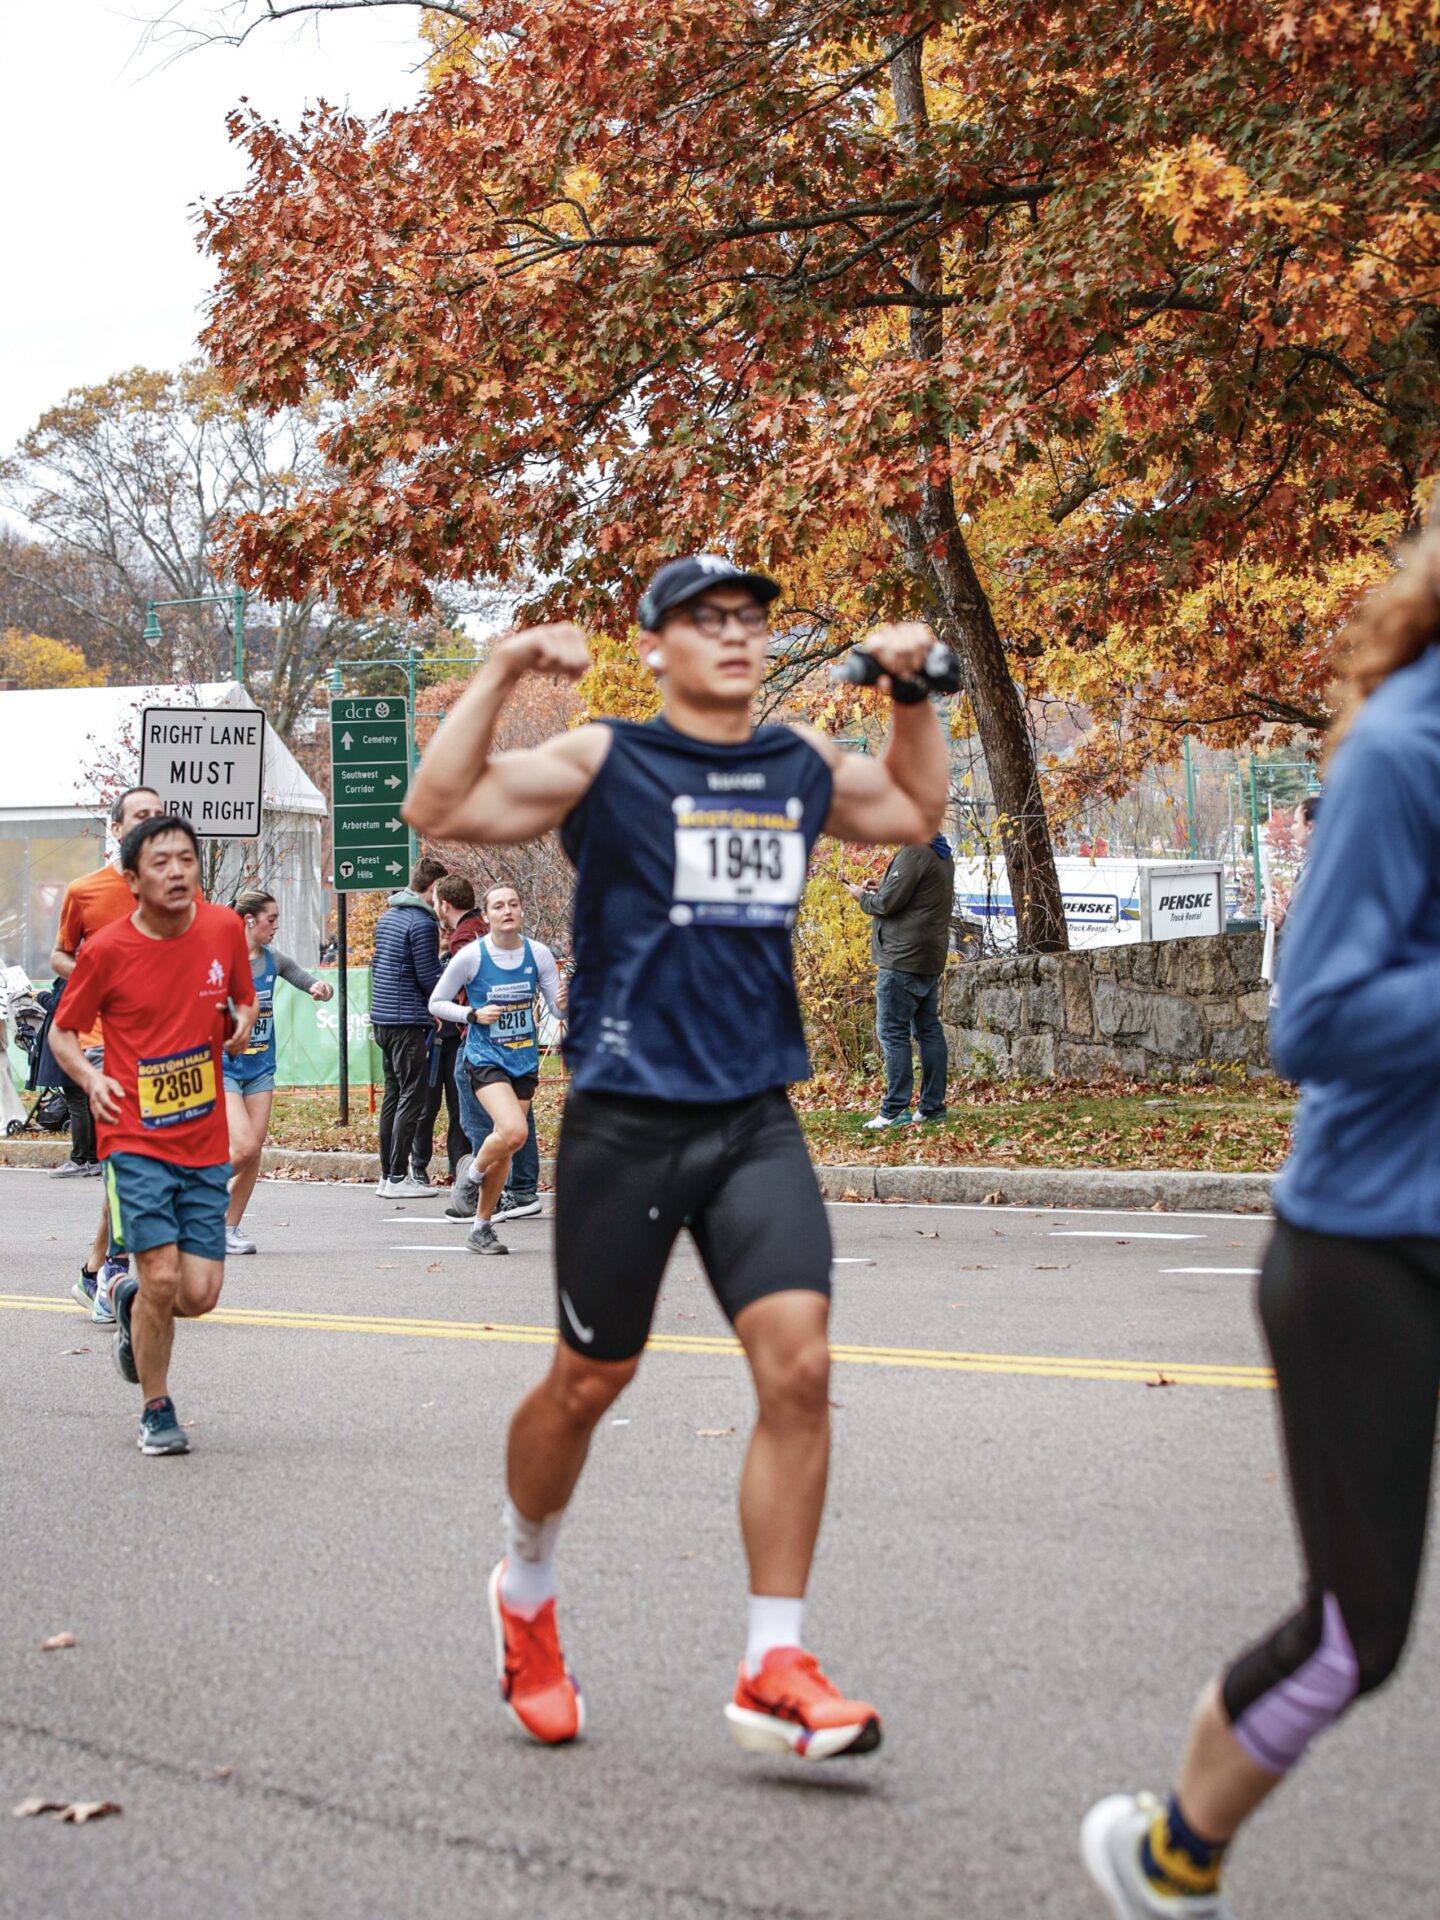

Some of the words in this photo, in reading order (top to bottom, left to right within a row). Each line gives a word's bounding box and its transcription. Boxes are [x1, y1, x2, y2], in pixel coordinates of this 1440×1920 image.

[345, 702, 372, 719] dcr
[150, 725, 203, 744] RIGHT
[210, 726, 257, 745] LANE
[362, 735, 397, 745] Cemetery
[170, 760, 235, 785] MUST
[341, 770, 379, 780] Southwest
[345, 784, 375, 794] Corridor
[164, 800, 193, 820] RN
[202, 801, 255, 820] RIGHT
[341, 821, 380, 830] Arboretum
[357, 855, 380, 864] Forest
[707, 836, 783, 881] 1943
[357, 870, 374, 879] Hills
[1159, 893, 1213, 911] PENSKE
[1170, 913, 1184, 922] Truck
[1185, 912, 1202, 921] Rental
[1068, 924, 1085, 932] Truck
[499, 1011, 527, 1031] 6218
[152, 1067, 203, 1105] 2360
